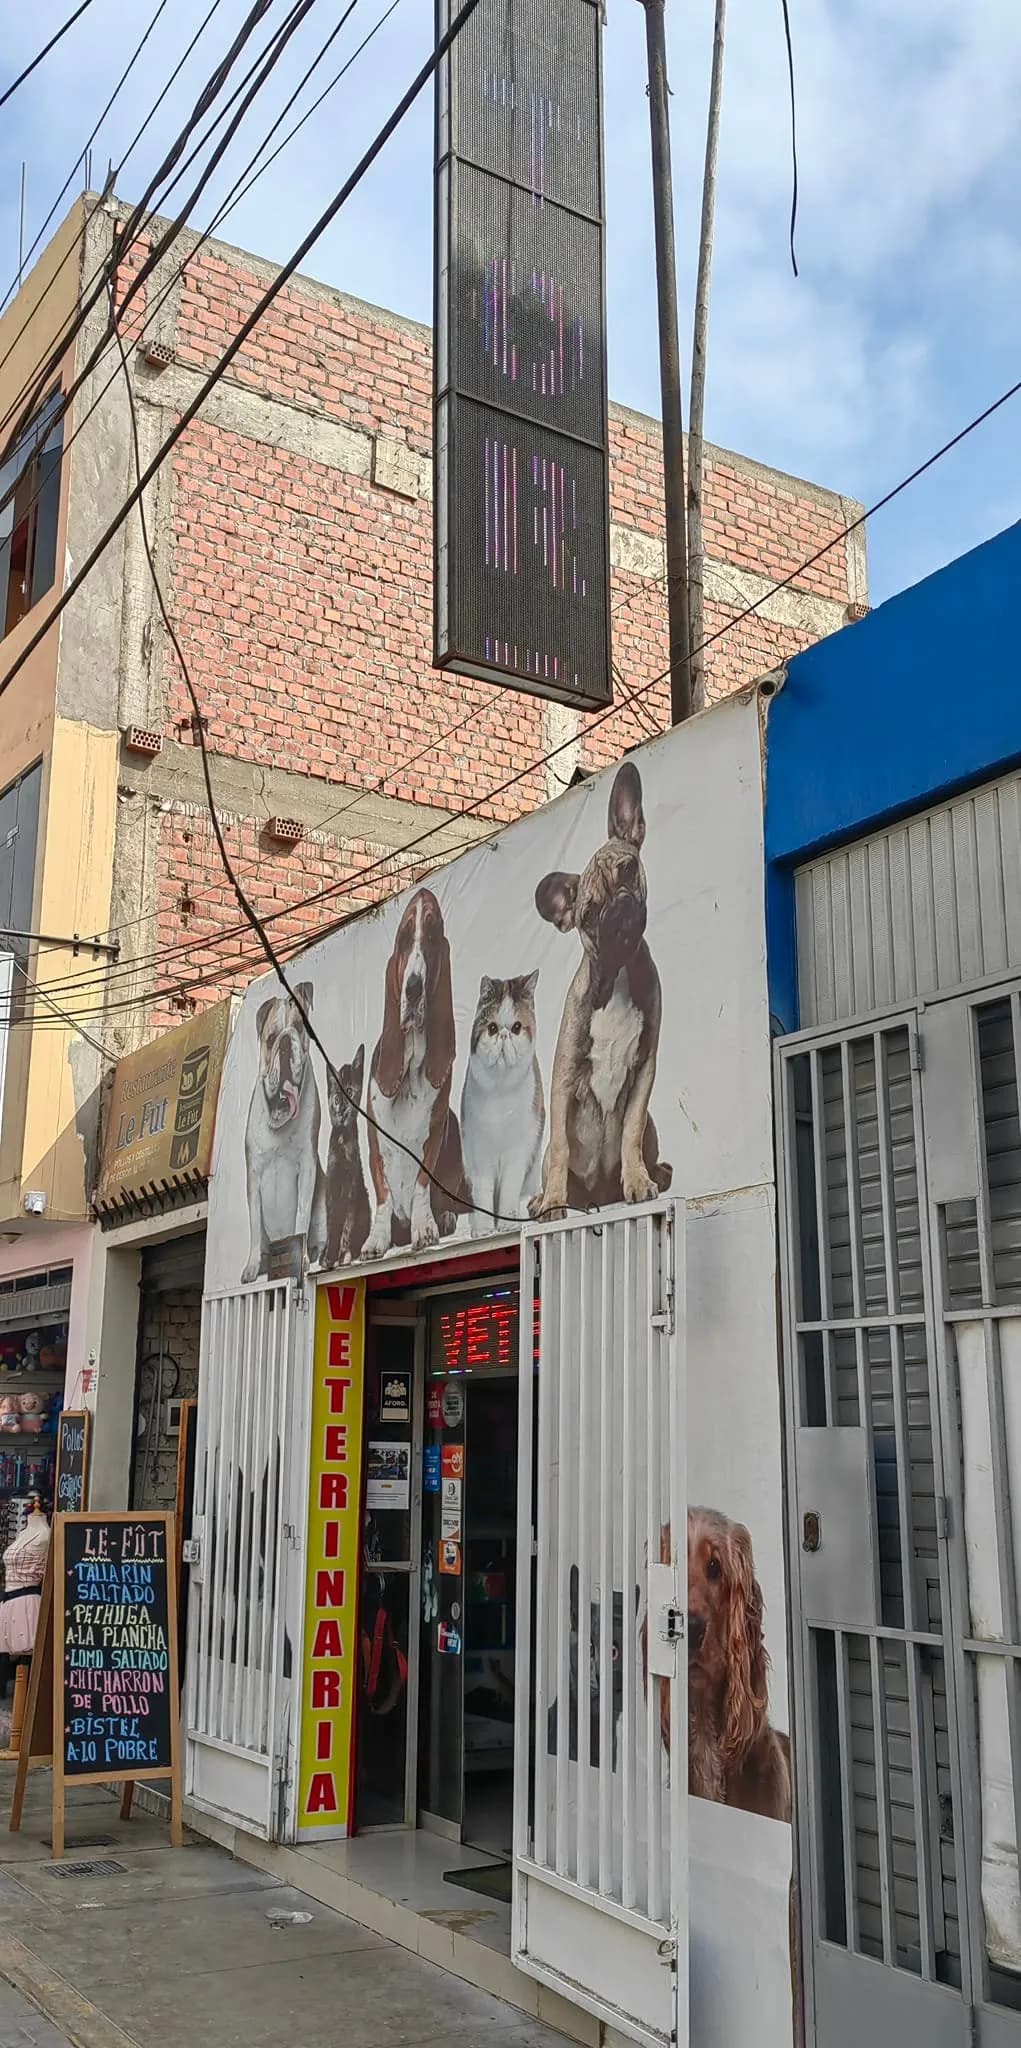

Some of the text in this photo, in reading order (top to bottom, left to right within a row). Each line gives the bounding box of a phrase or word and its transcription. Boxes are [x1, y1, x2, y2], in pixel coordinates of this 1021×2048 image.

[115, 1111, 135, 1150] Le
[440, 1299, 541, 1365] VET
[306, 1285, 357, 1813] VETERINARIA
[77, 1583, 155, 1604] SALTADO
[73, 1604, 151, 1625] PECHUGA
[102, 1624, 168, 1651] PLANCHA
[70, 1648, 168, 1671] LOMO SALTADO
[69, 1668, 164, 1694] CHICHARRON
[71, 1694, 150, 1716] DE POLLO
[105, 1737, 158, 1762] POBRE
